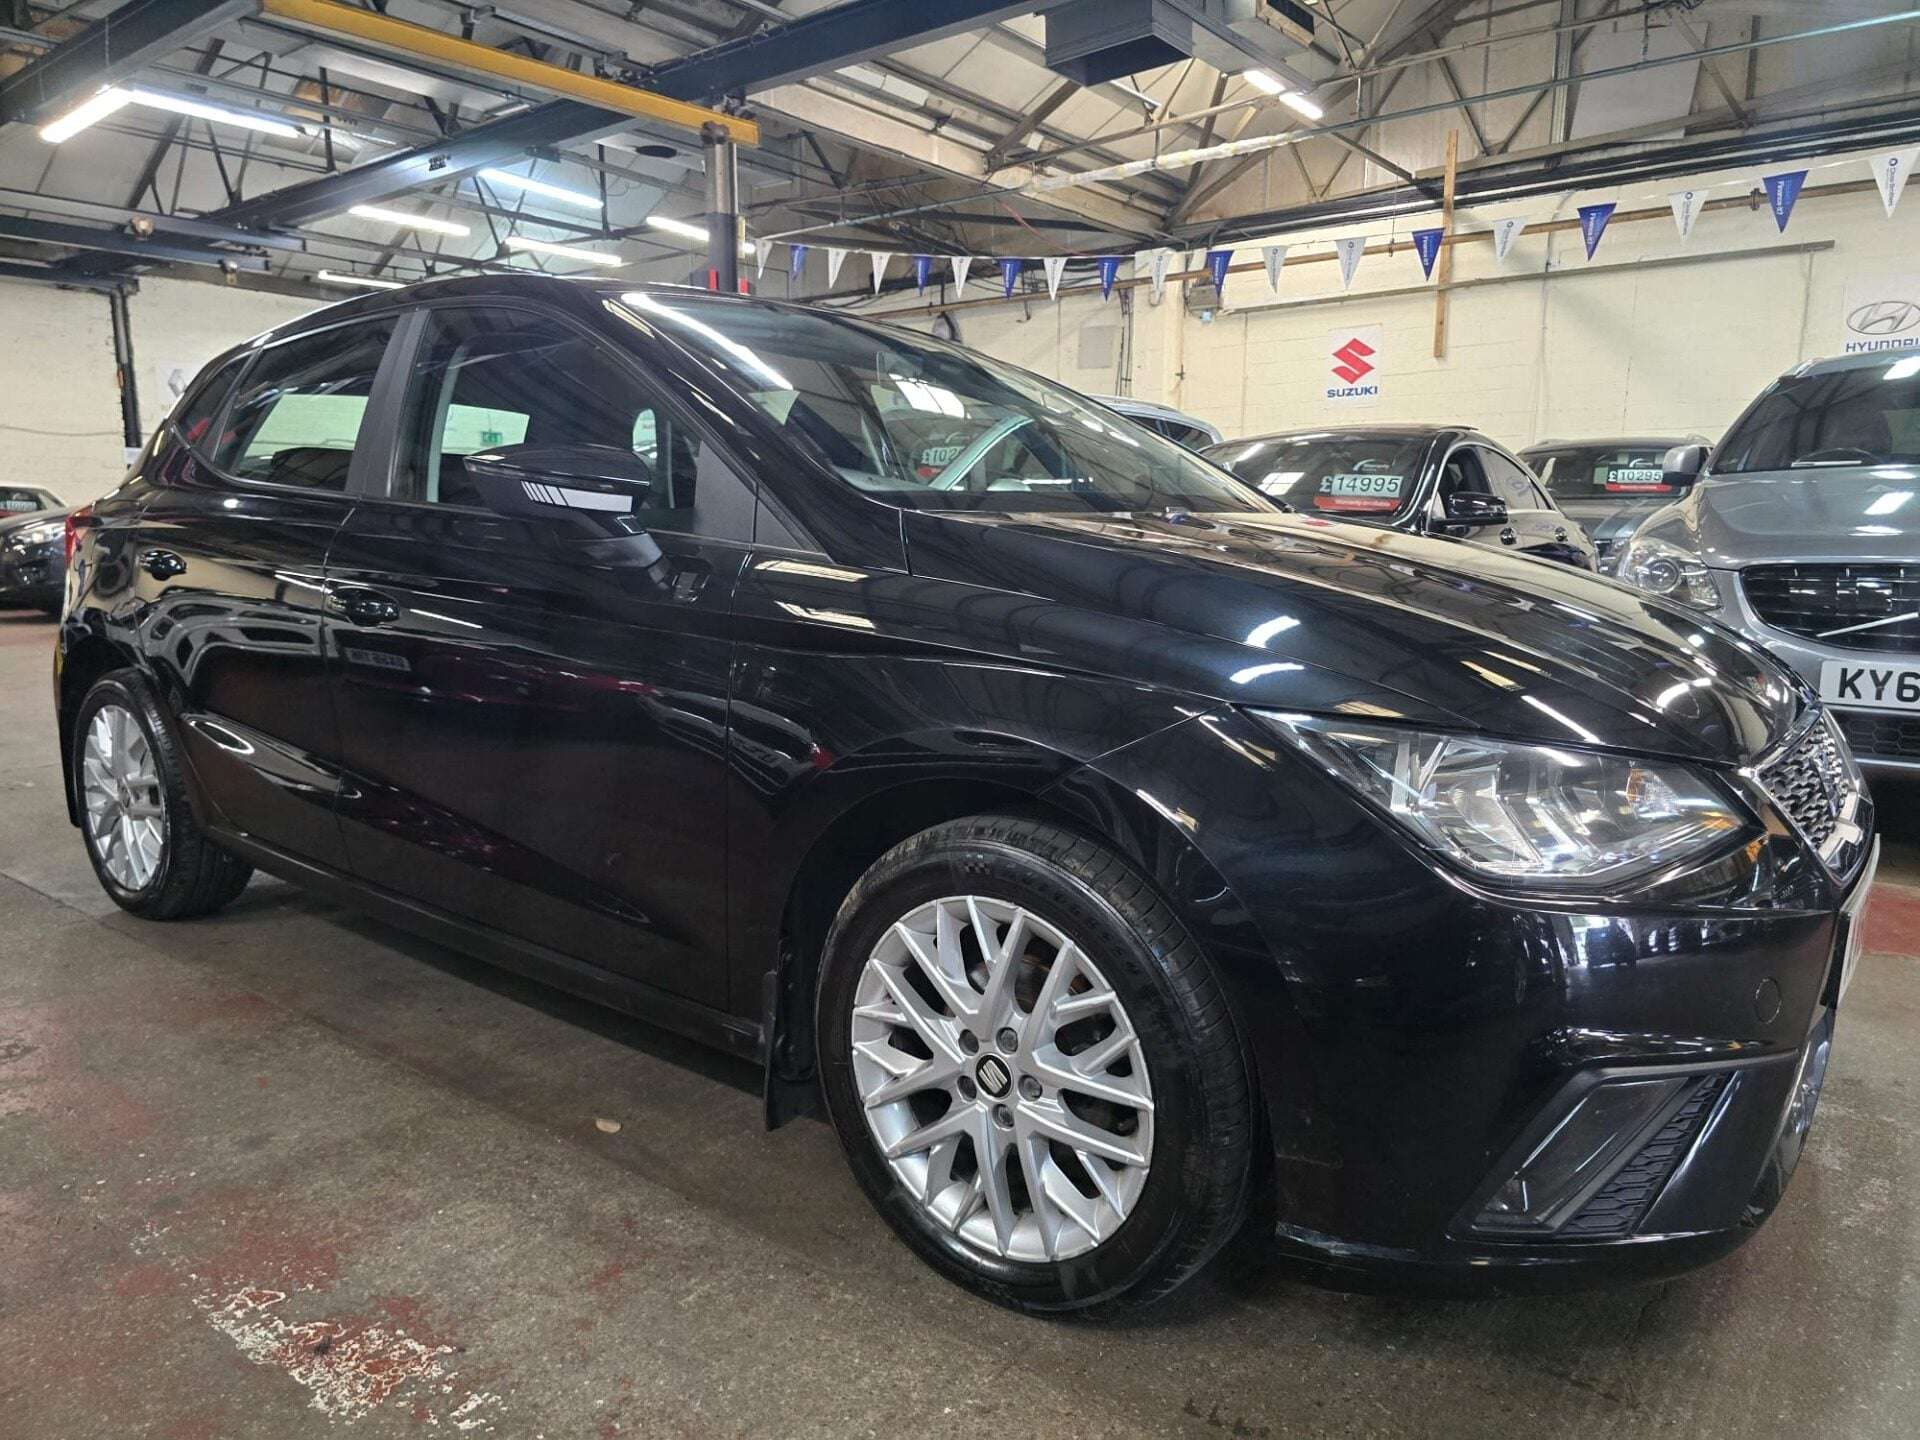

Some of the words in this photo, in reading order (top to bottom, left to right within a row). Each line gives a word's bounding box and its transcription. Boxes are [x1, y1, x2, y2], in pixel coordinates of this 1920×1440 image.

[1777, 180, 1785, 206] Finance
[1327, 386, 1378, 398] SUZUKI
[1319, 476, 1399, 493] £14995
